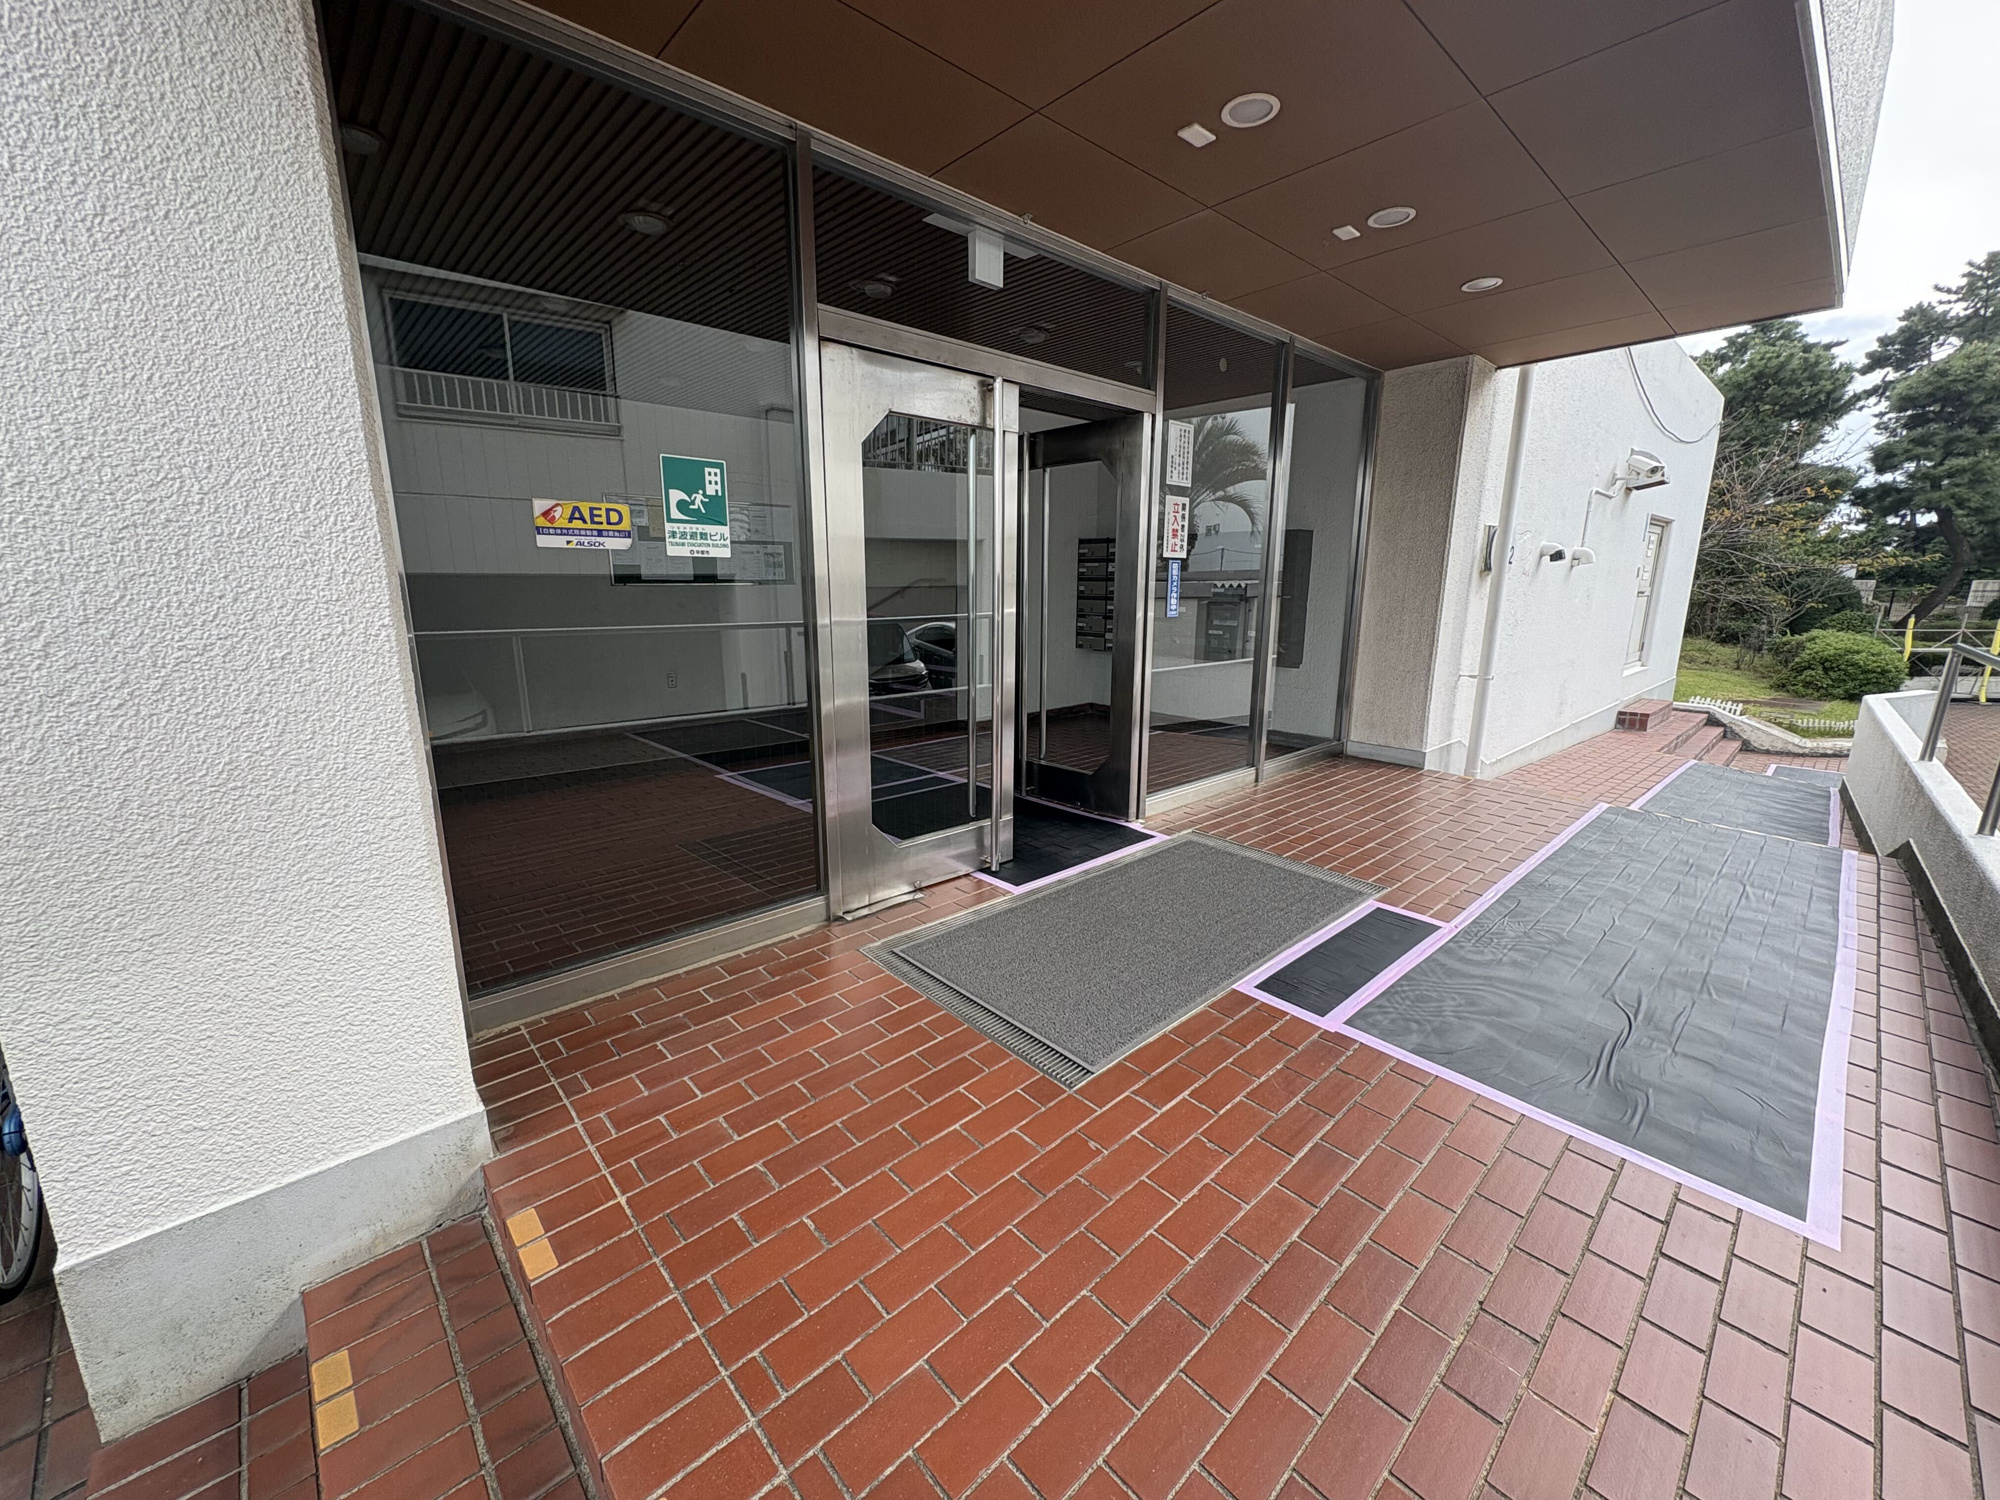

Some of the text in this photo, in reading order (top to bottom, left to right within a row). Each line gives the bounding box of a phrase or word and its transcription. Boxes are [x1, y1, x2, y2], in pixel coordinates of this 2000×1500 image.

[568, 506, 624, 526] AED
[1170, 502, 1180, 553] 立入禁止
[575, 540, 606, 548] ALSOK
[667, 530, 729, 542] 津波避難ビル
